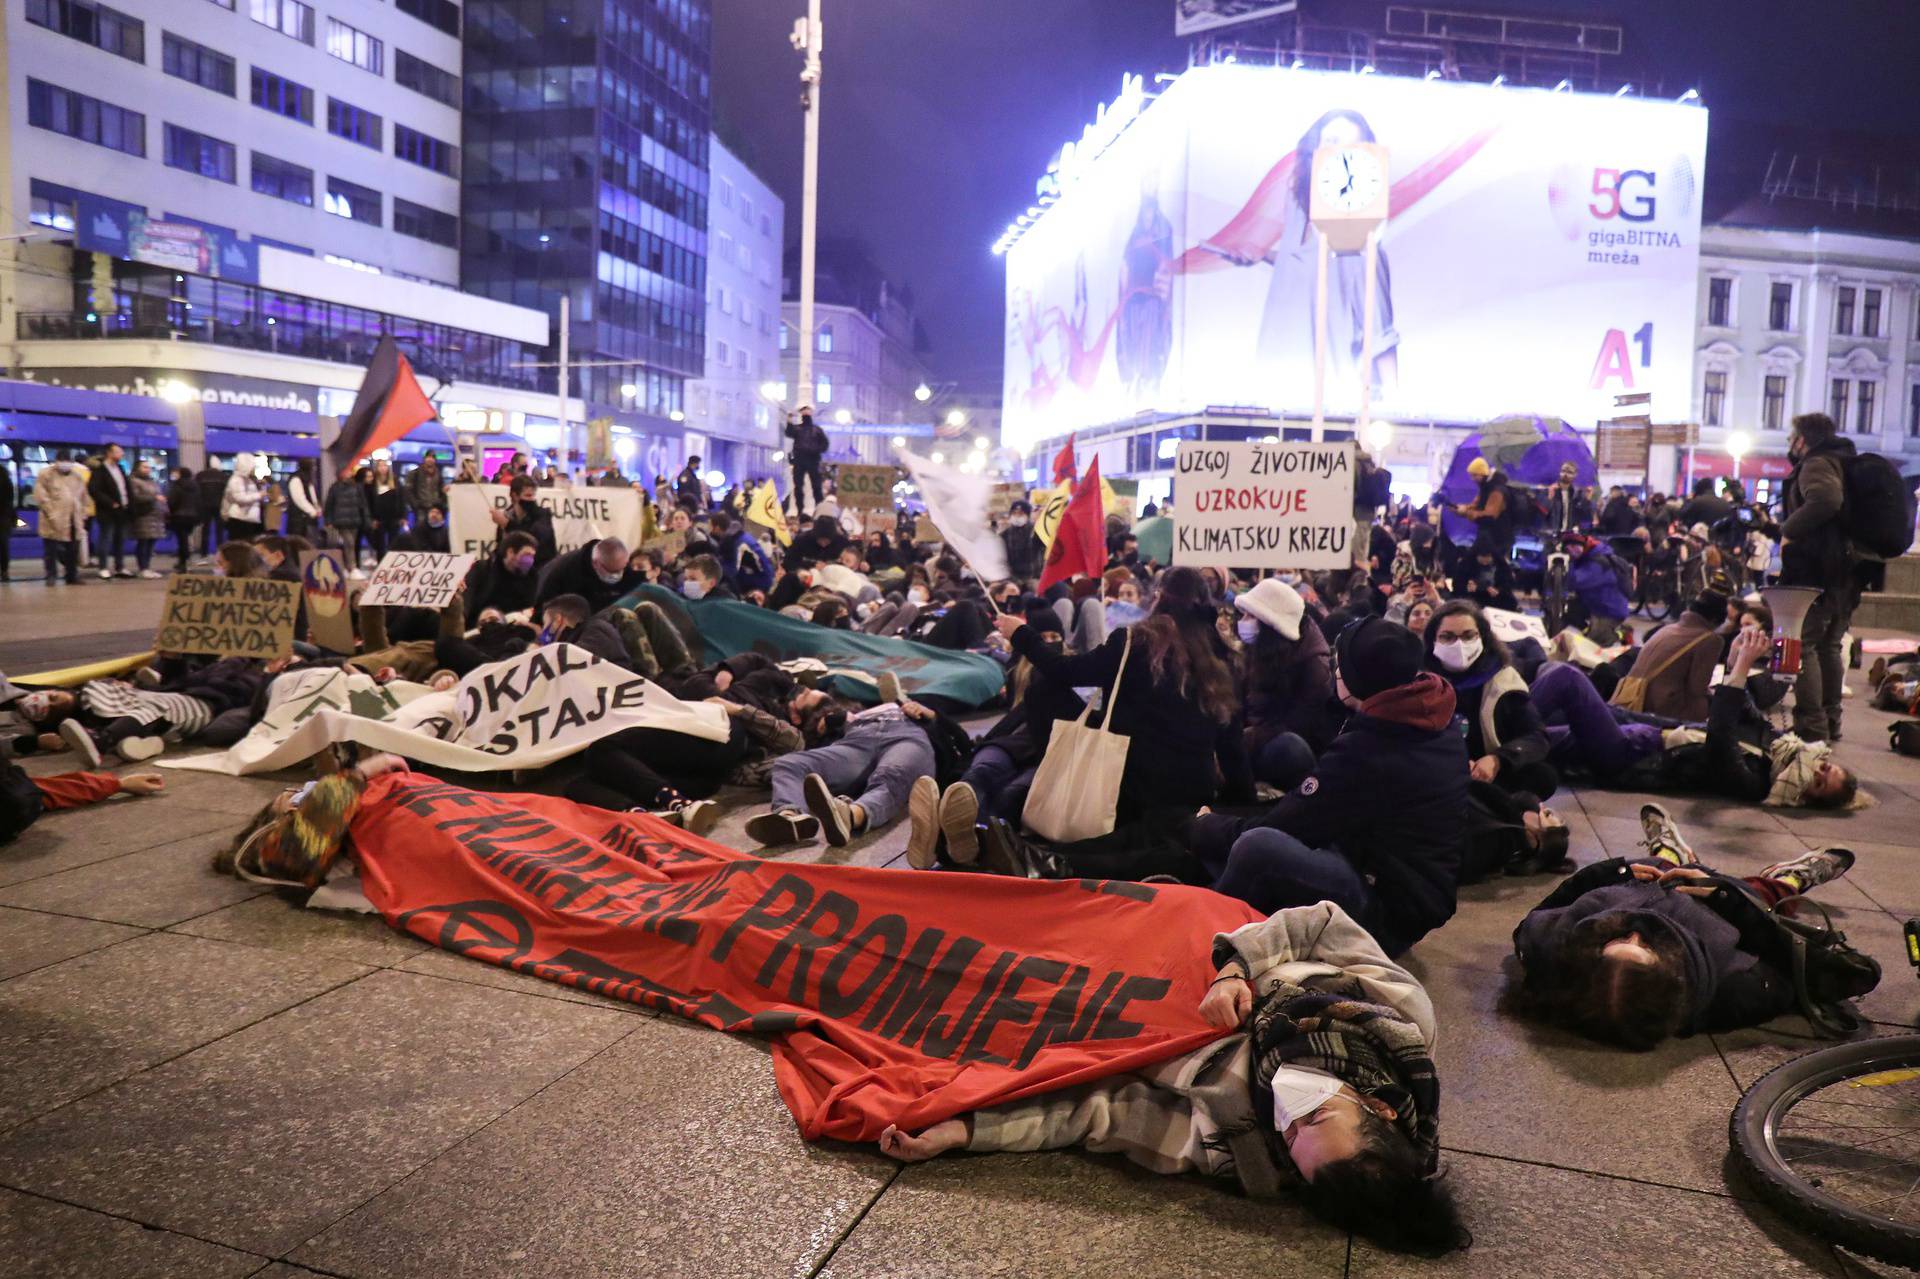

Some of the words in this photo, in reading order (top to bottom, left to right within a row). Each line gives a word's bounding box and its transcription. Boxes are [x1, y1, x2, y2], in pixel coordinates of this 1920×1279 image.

[1588, 167, 1656, 223] 5G
[1588, 230, 1681, 248] gigaBITNA
[1587, 250, 1640, 266] mreža
[1589, 322, 1654, 389] A1
[1179, 450, 1230, 479] UZGOJ
[1250, 446, 1347, 479] ŽIVOTINJA
[1195, 486, 1308, 516] UZROKUJE
[1179, 525, 1280, 553] KLIMATSKU
[1289, 526, 1346, 553] KRIZU
[390, 553, 461, 570] DONT
[170, 578, 235, 598] JEDINA
[244, 581, 292, 604] NADA
[372, 569, 417, 585] BURN
[419, 571, 455, 588] OUR
[168, 601, 292, 627] KLIMATSKA
[183, 626, 279, 653] PRAVDA
[709, 873, 1172, 1070] PROMJENE
